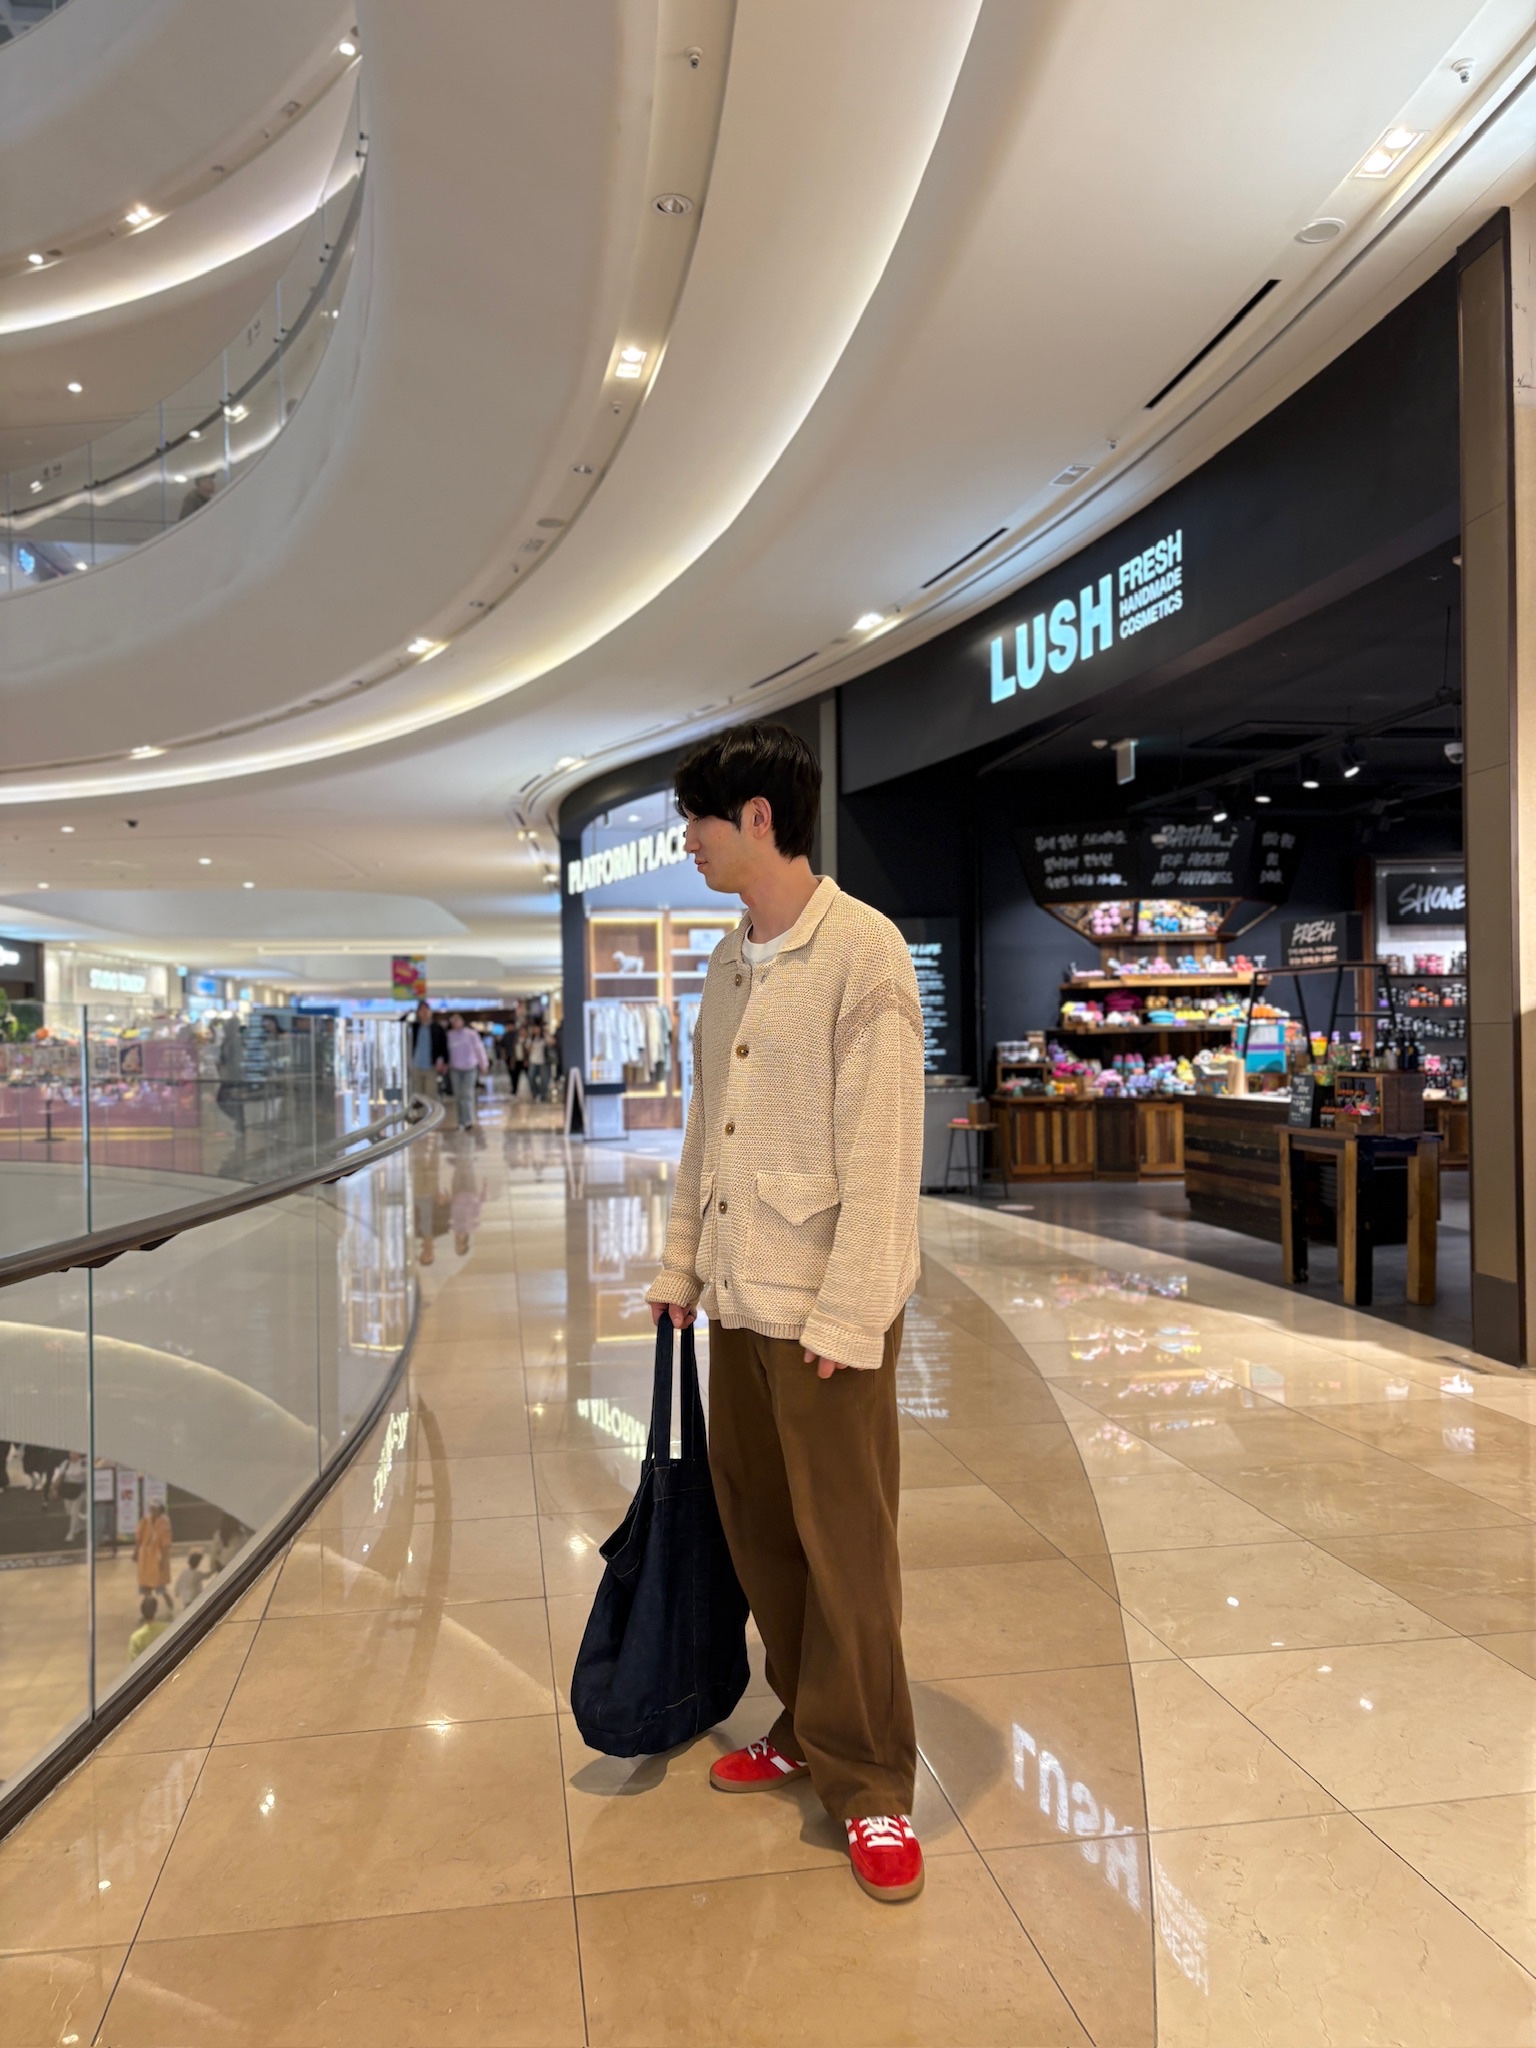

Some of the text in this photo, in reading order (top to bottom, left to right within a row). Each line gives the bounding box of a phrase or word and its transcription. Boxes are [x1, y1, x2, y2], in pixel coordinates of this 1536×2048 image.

[1119, 529, 1182, 597] FRESH
[1119, 566, 1182, 618] HANDMADE
[991, 573, 1113, 704] LUSH
[1119, 590, 1183, 640] COSMETICS
[568, 823, 689, 896] PLATFORM PLACE
[1291, 919, 1336, 947] FRESH
